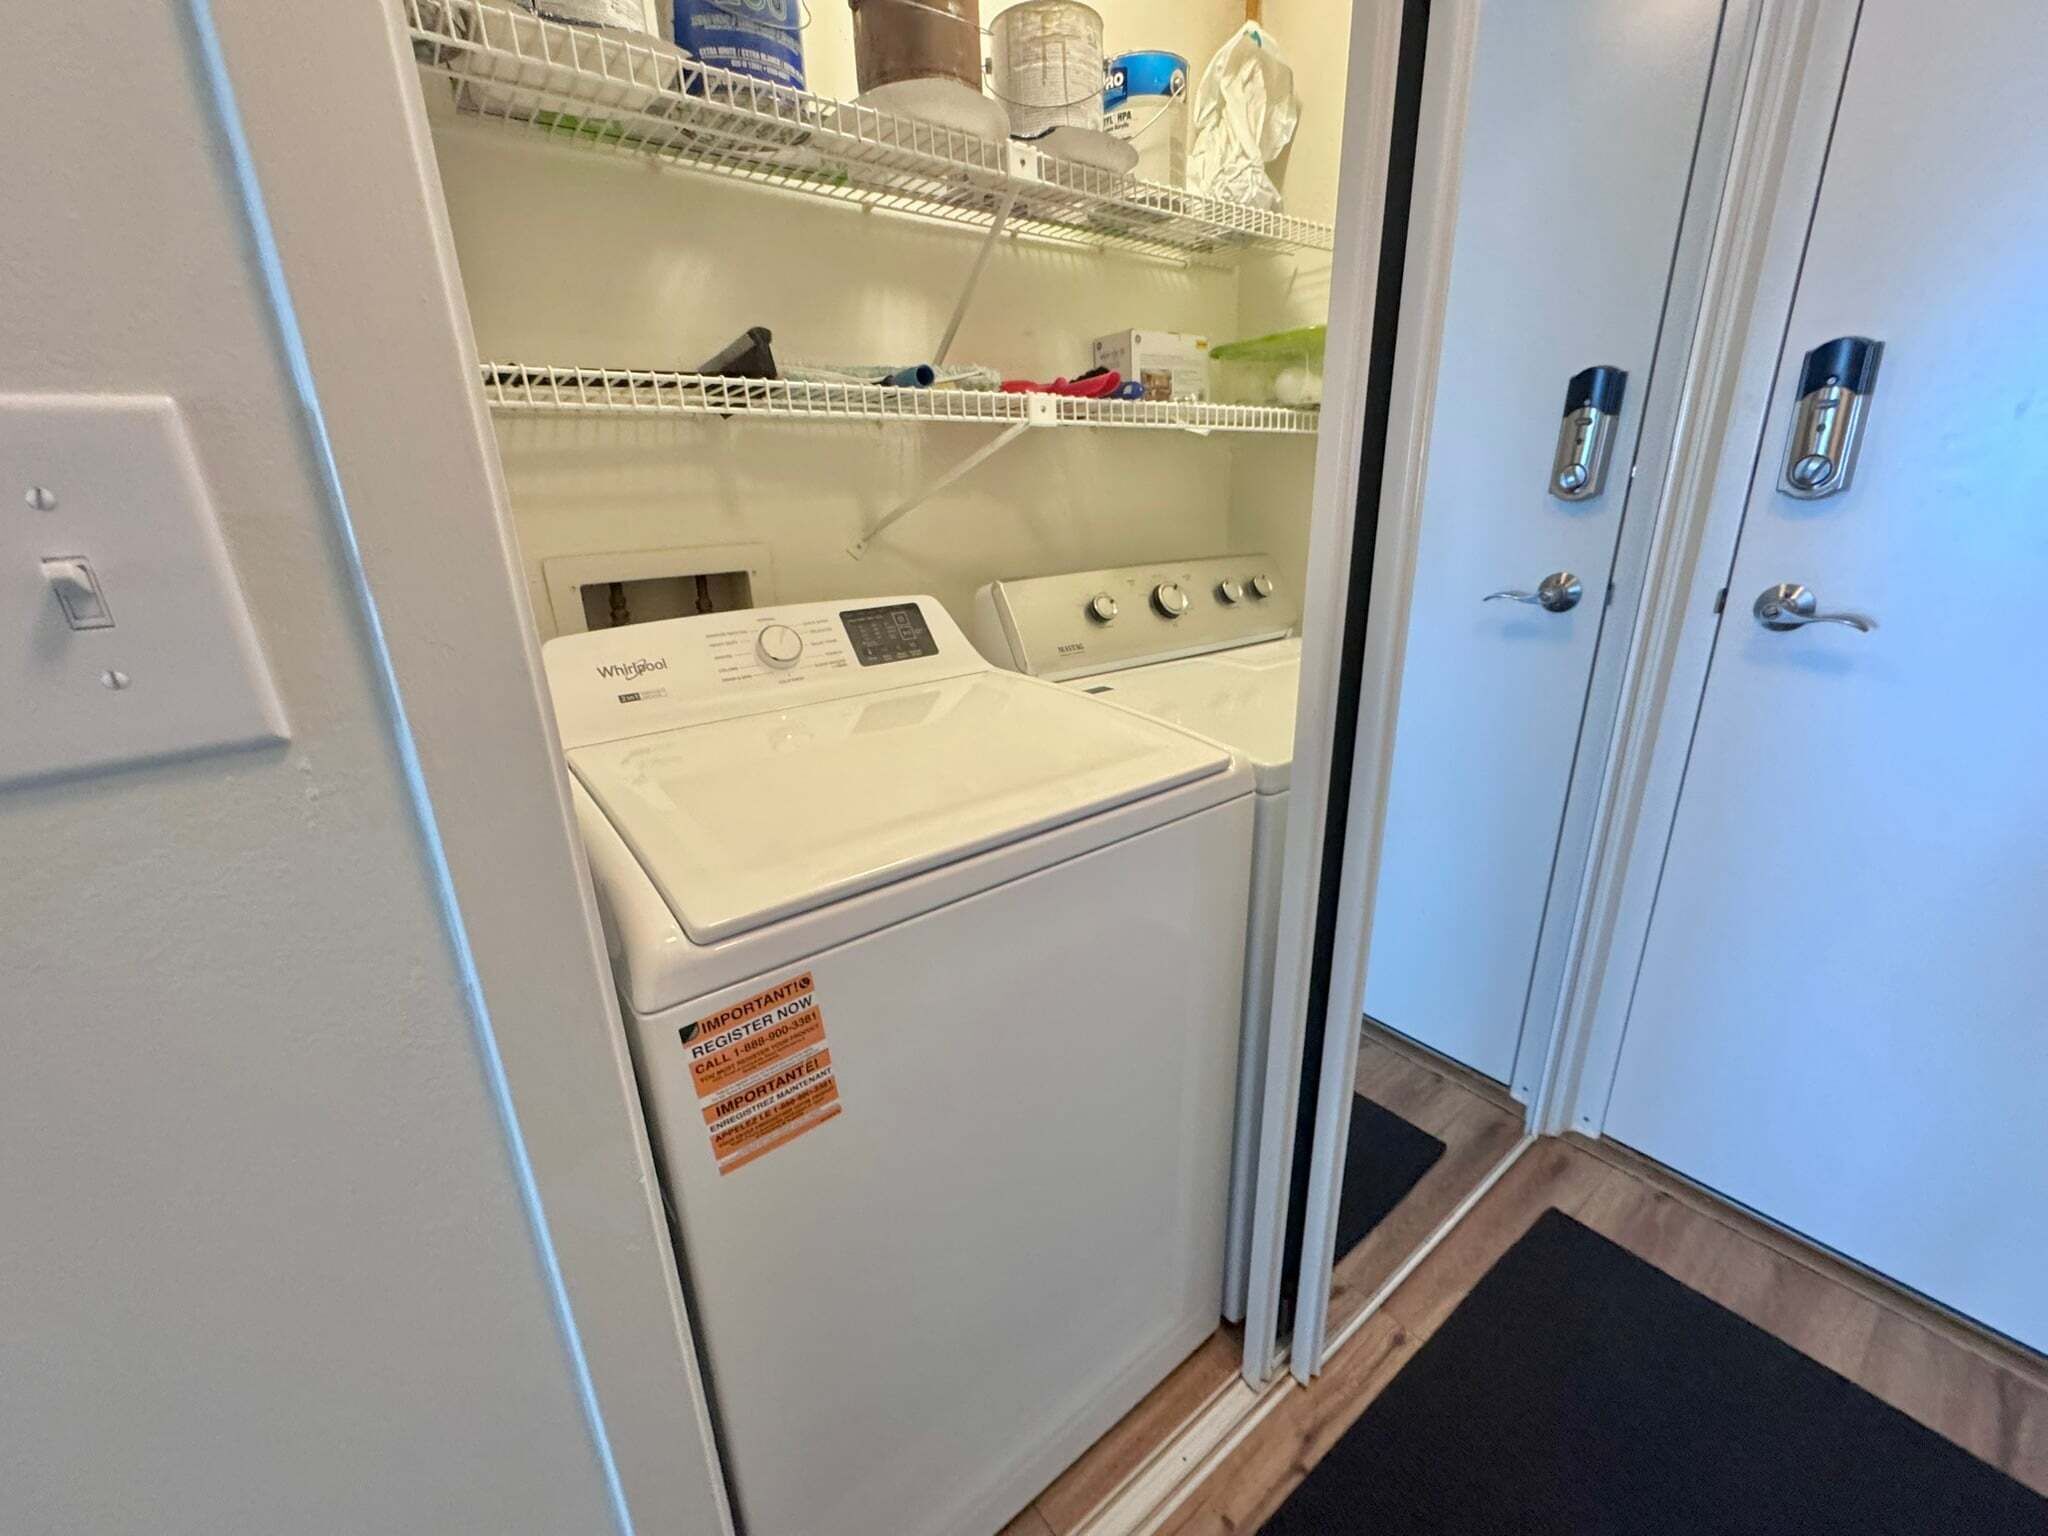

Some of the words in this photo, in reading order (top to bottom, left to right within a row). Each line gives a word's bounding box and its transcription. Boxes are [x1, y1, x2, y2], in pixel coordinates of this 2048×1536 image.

[596, 658, 668, 681] Whirlpool
[692, 1014, 774, 1058] REGISTER
[777, 995, 812, 1020] NOW
[701, 982, 799, 1034] IMPORTANT!
[695, 1054, 730, 1074] CALL
[709, 1097, 775, 1133] ENREGISTREZ
[776, 1067, 832, 1101] MAINTENANT
